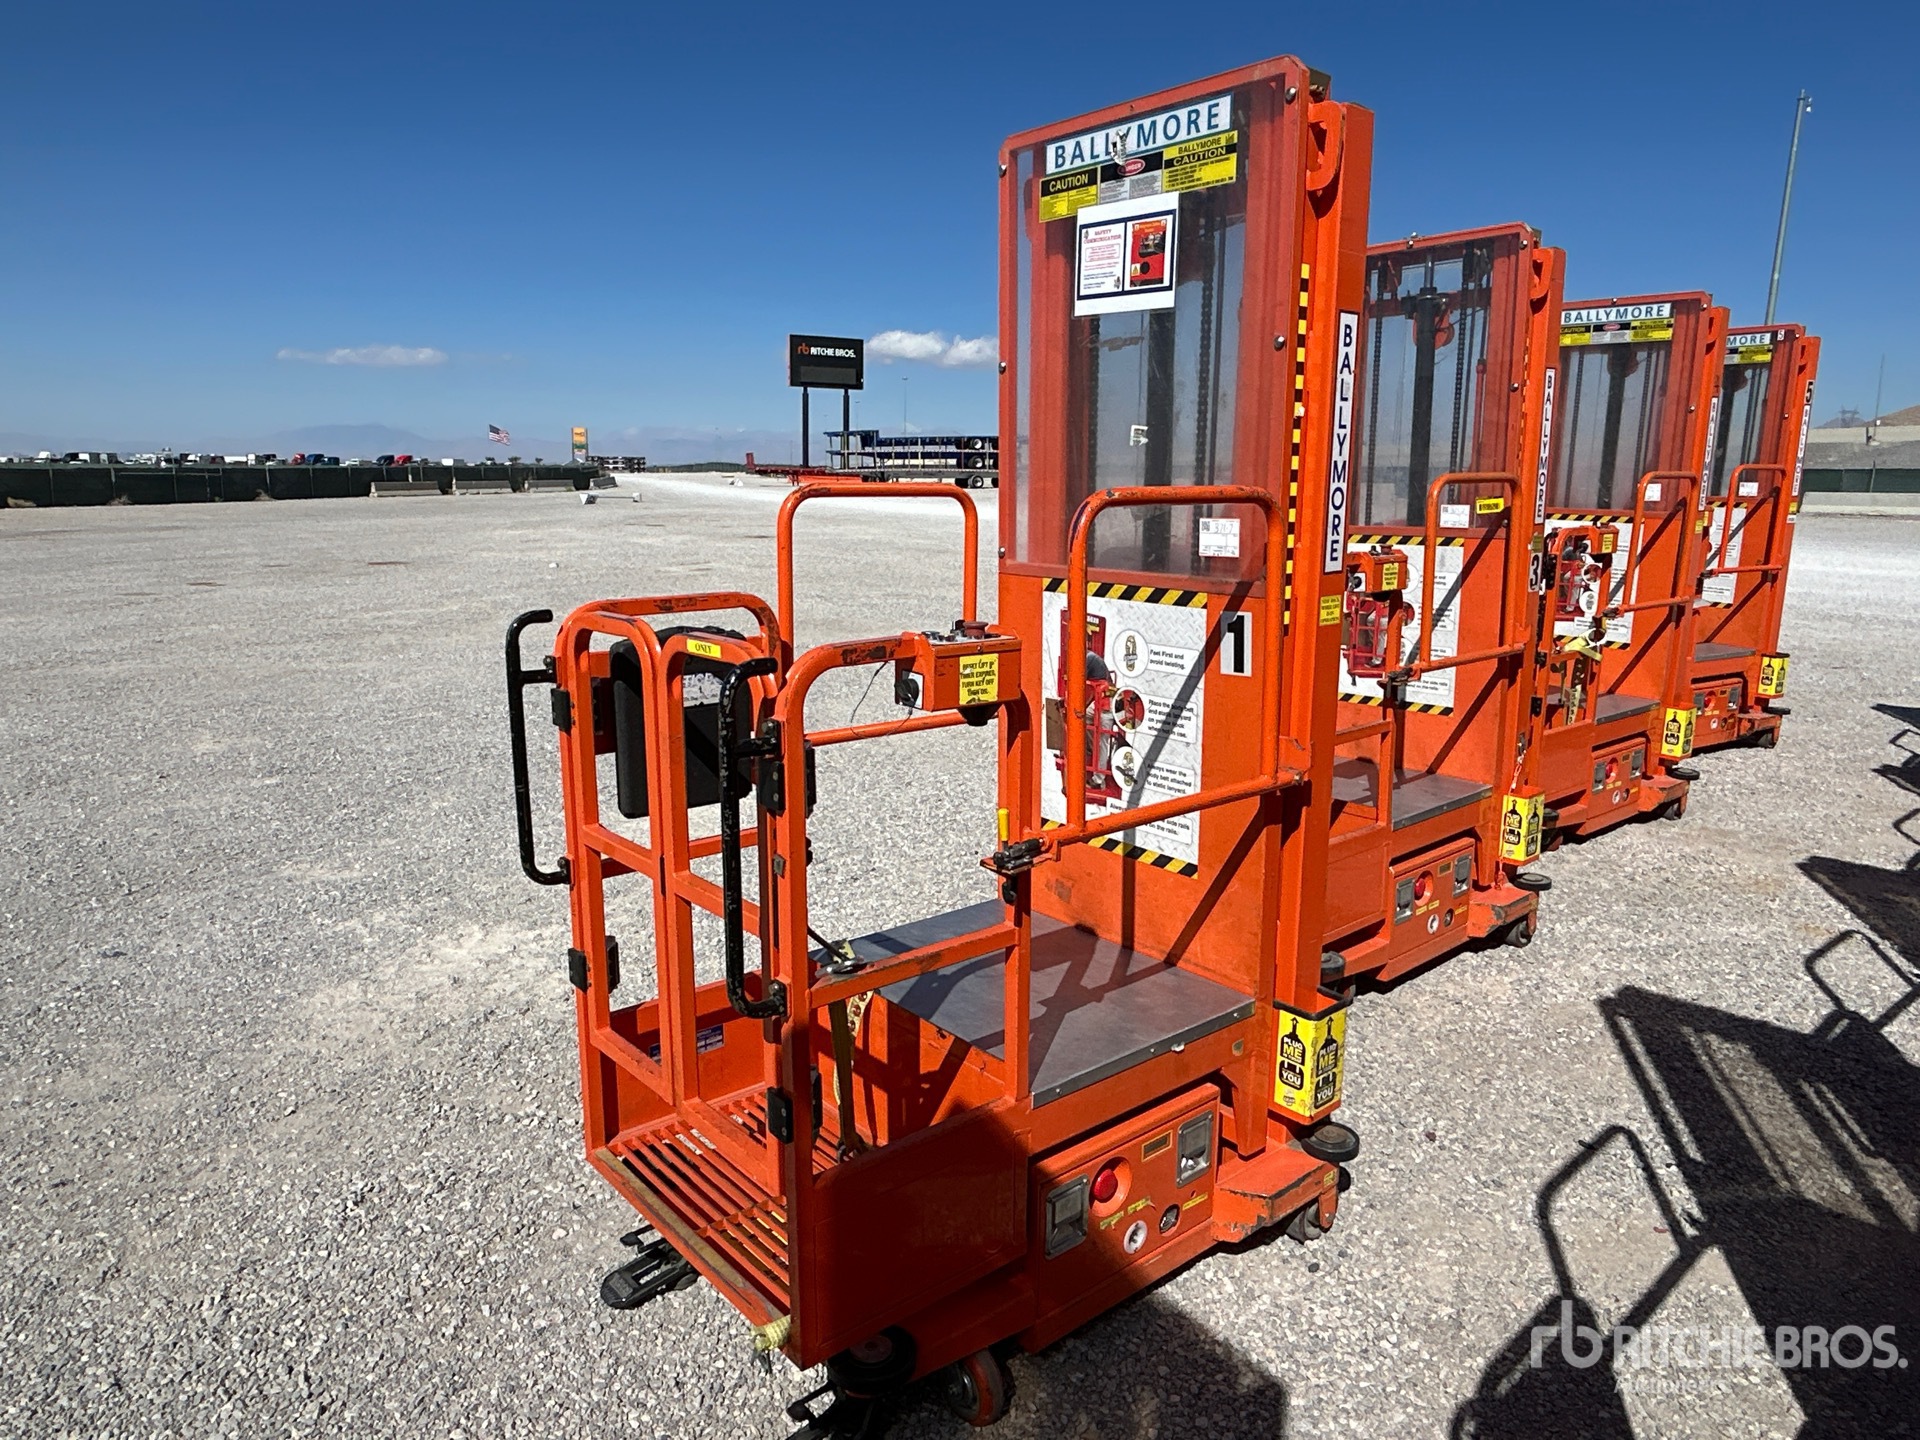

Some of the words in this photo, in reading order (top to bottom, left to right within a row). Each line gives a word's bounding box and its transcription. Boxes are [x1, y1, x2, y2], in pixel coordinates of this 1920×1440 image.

[1178, 137, 1222, 154] BALLYMORE
[1173, 147, 1226, 166] CAUTION
[1049, 173, 1088, 192] CAUTION
[1564, 305, 1665, 323] BALLYMORE
[810, 347, 834, 356] RITCHIE
[1805, 381, 1814, 402] 5
[1329, 324, 1352, 562] BALLYMORE
[1536, 375, 1553, 518] BALLYMORE
[1529, 554, 1540, 590] 3
[694, 643, 712, 654] ONLY
[1227, 614, 1245, 673] 1
[1283, 1043, 1303, 1059] ME
[1284, 1036, 1303, 1051] PLUG
[1320, 1043, 1337, 1056] PLUG
[1320, 1052, 1336, 1072] ME
[1282, 1070, 1301, 1085] YOU
[1317, 1086, 1334, 1100] YOU
